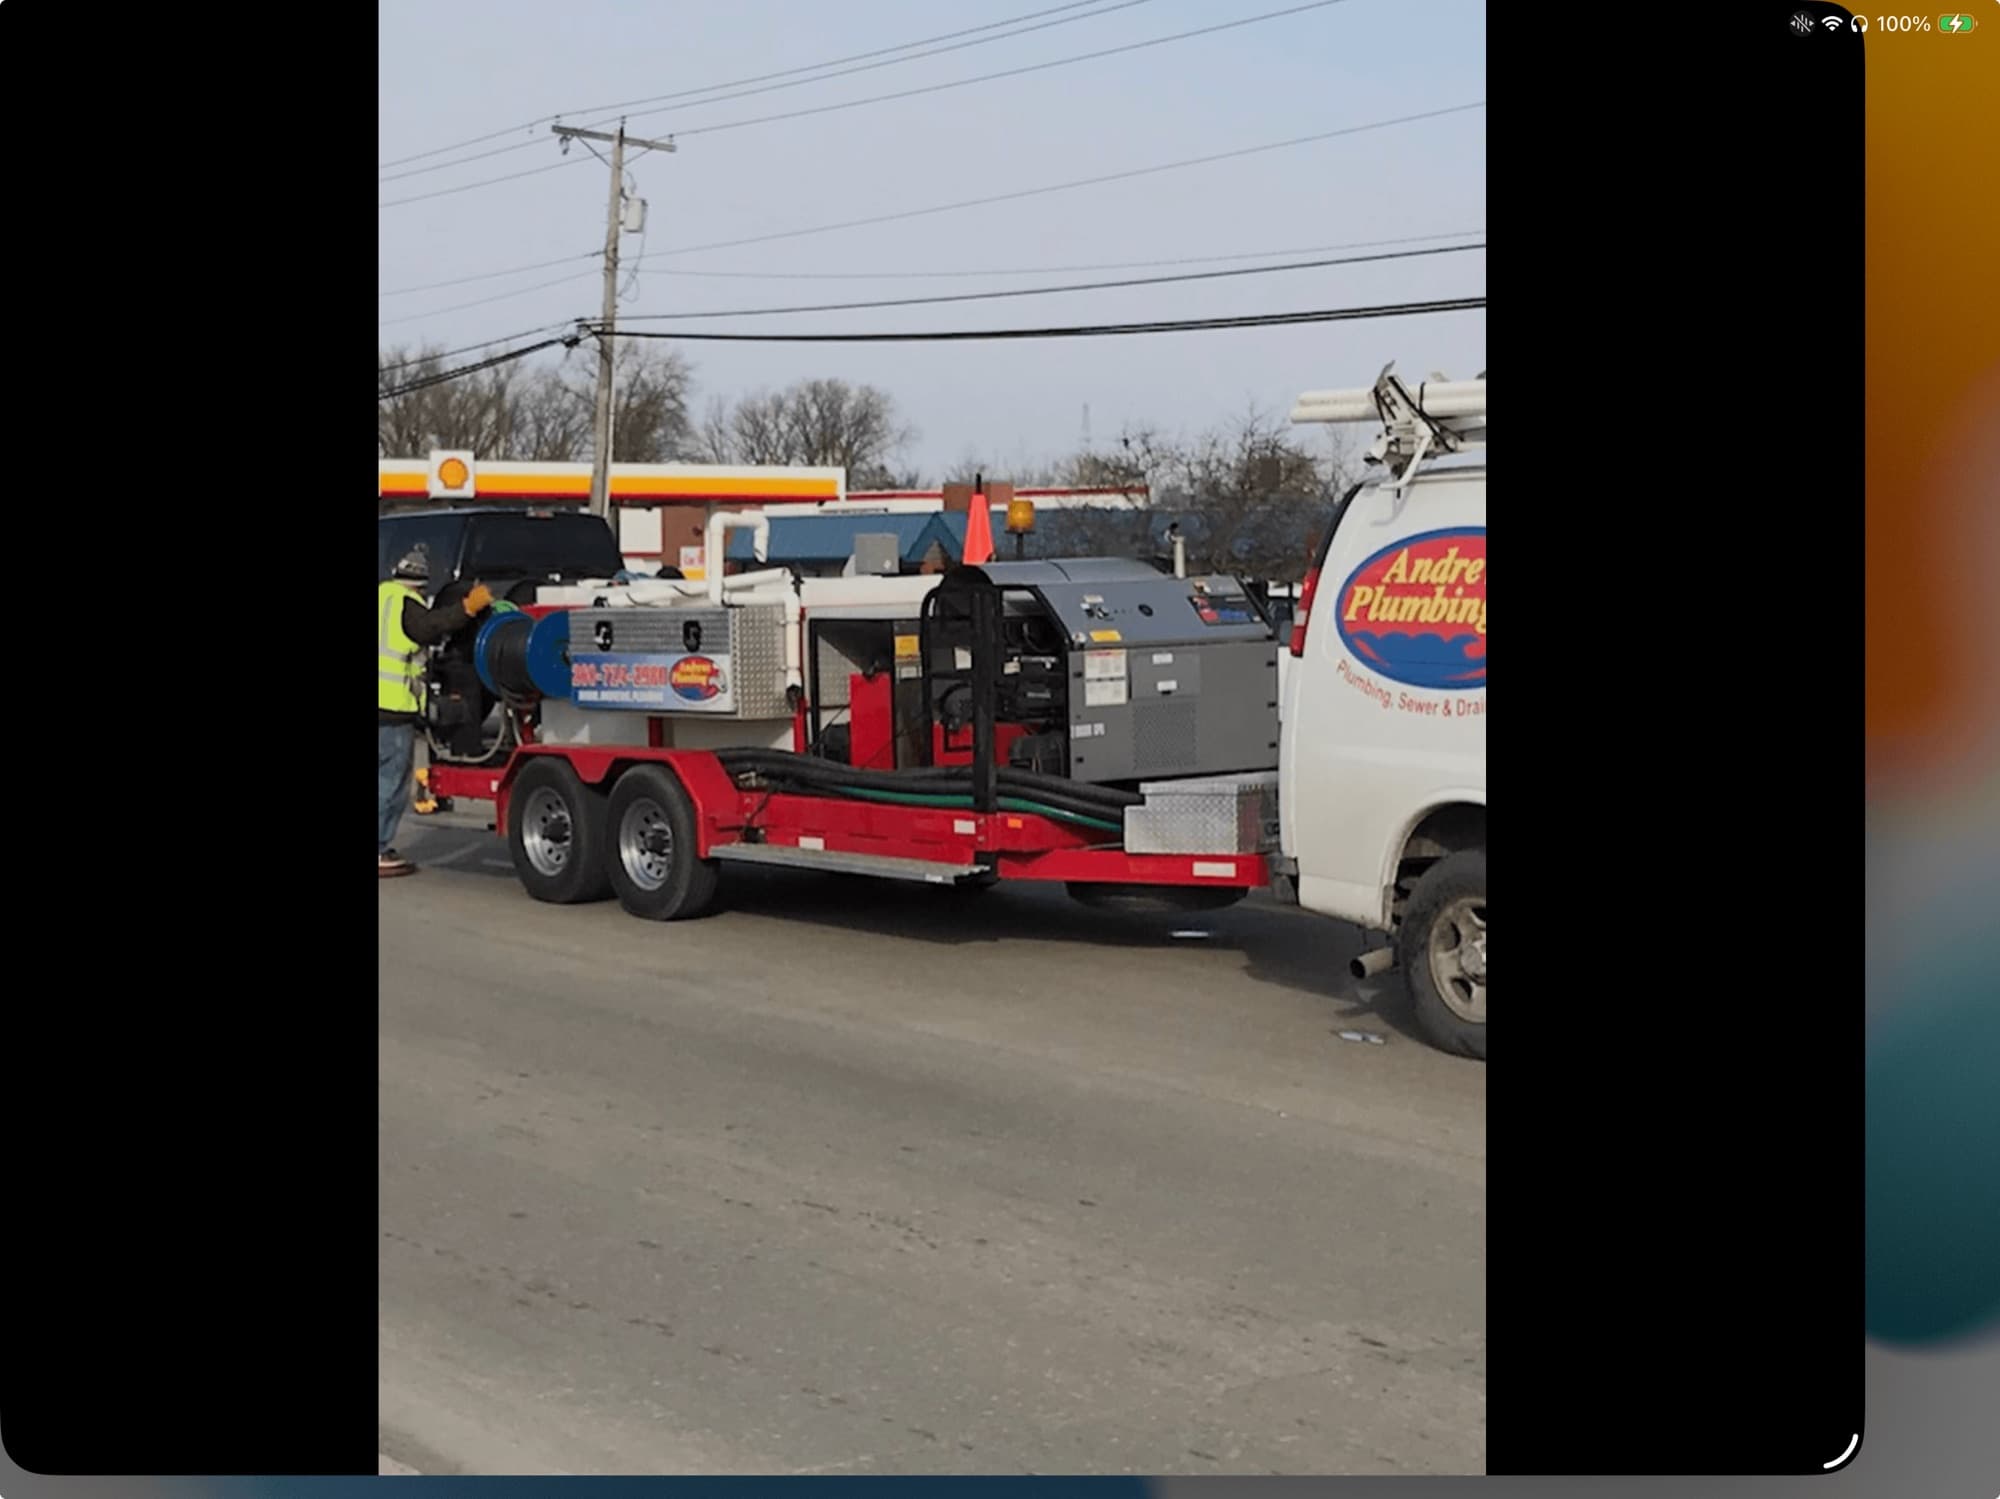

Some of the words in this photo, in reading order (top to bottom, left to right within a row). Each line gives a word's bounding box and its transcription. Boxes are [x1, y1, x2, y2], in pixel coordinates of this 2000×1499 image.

[1381, 547, 1484, 585] Andre
[1398, 692, 1438, 715] Sewer
[1442, 698, 1452, 717] &
